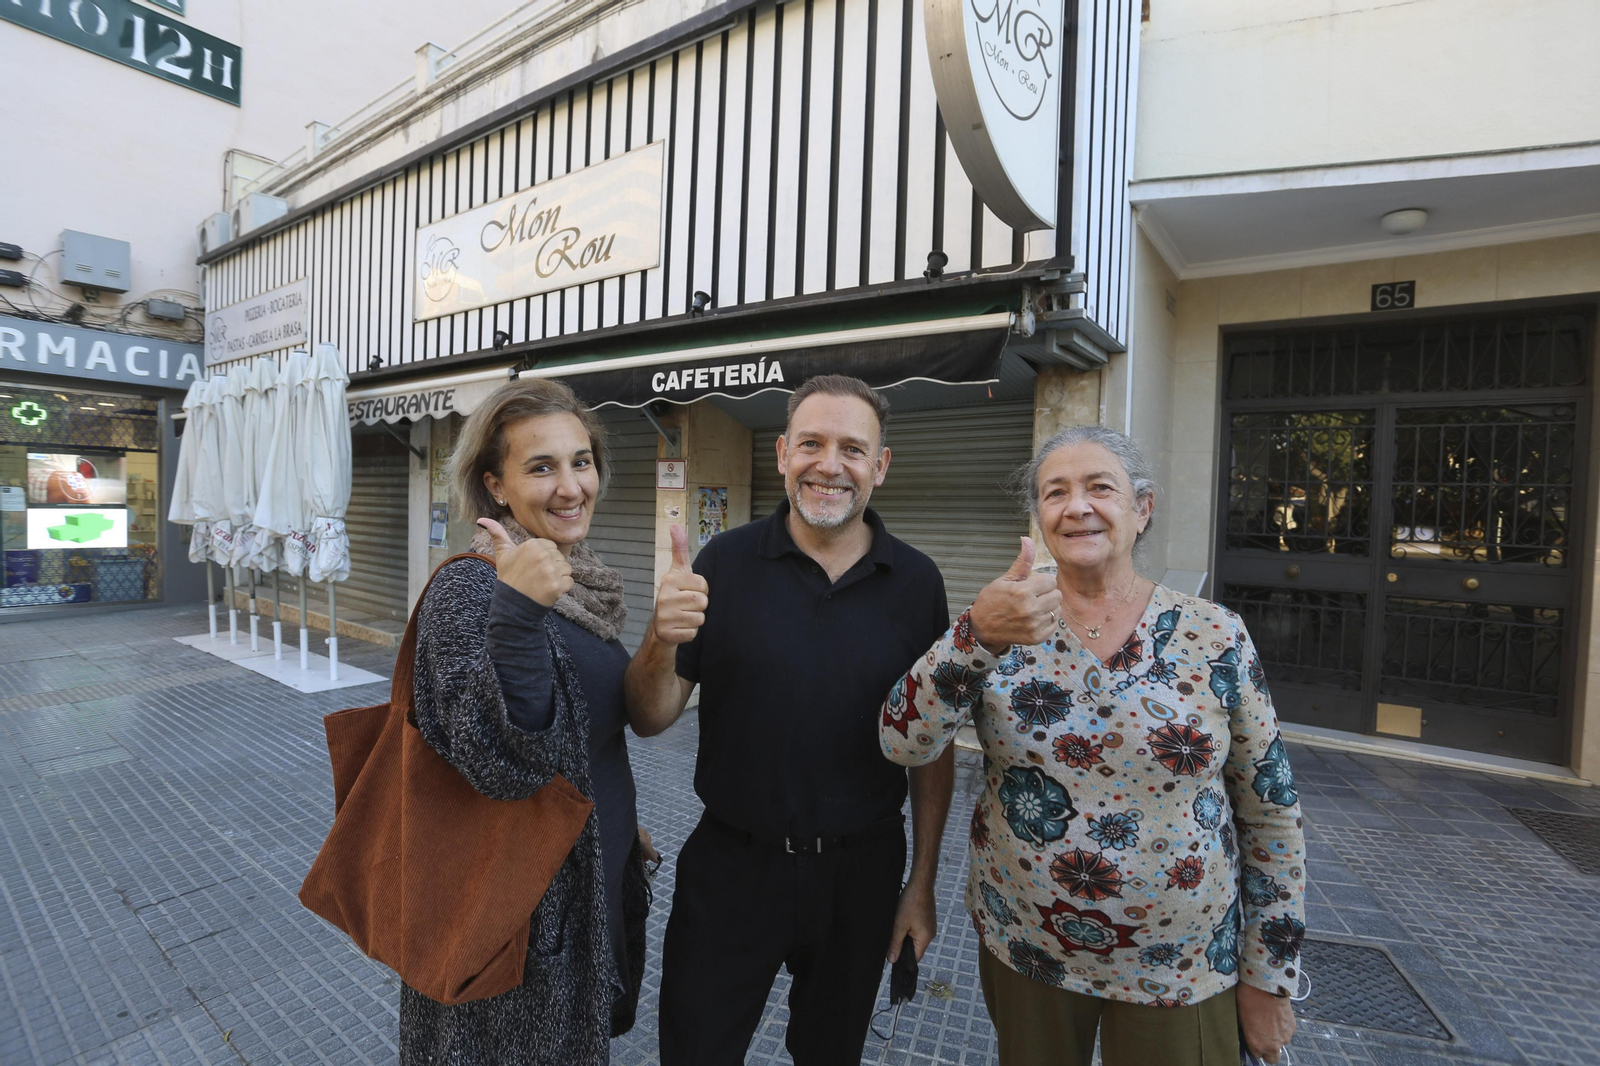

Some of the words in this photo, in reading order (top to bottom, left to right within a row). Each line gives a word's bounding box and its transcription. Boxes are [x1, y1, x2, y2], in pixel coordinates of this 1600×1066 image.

[130, 13, 235, 90] 12H
[984, 41, 1009, 71] Mon
[1018, 69, 1038, 95] Rou
[480, 197, 562, 253] Mon
[534, 226, 617, 278] Rou
[245, 304, 267, 322] PIZZERIA
[1376, 282, 1410, 308] 65
[274, 327, 282, 341] LA
[282, 321, 303, 338] BRASA
[651, 356, 785, 393] CAFETERÍA
